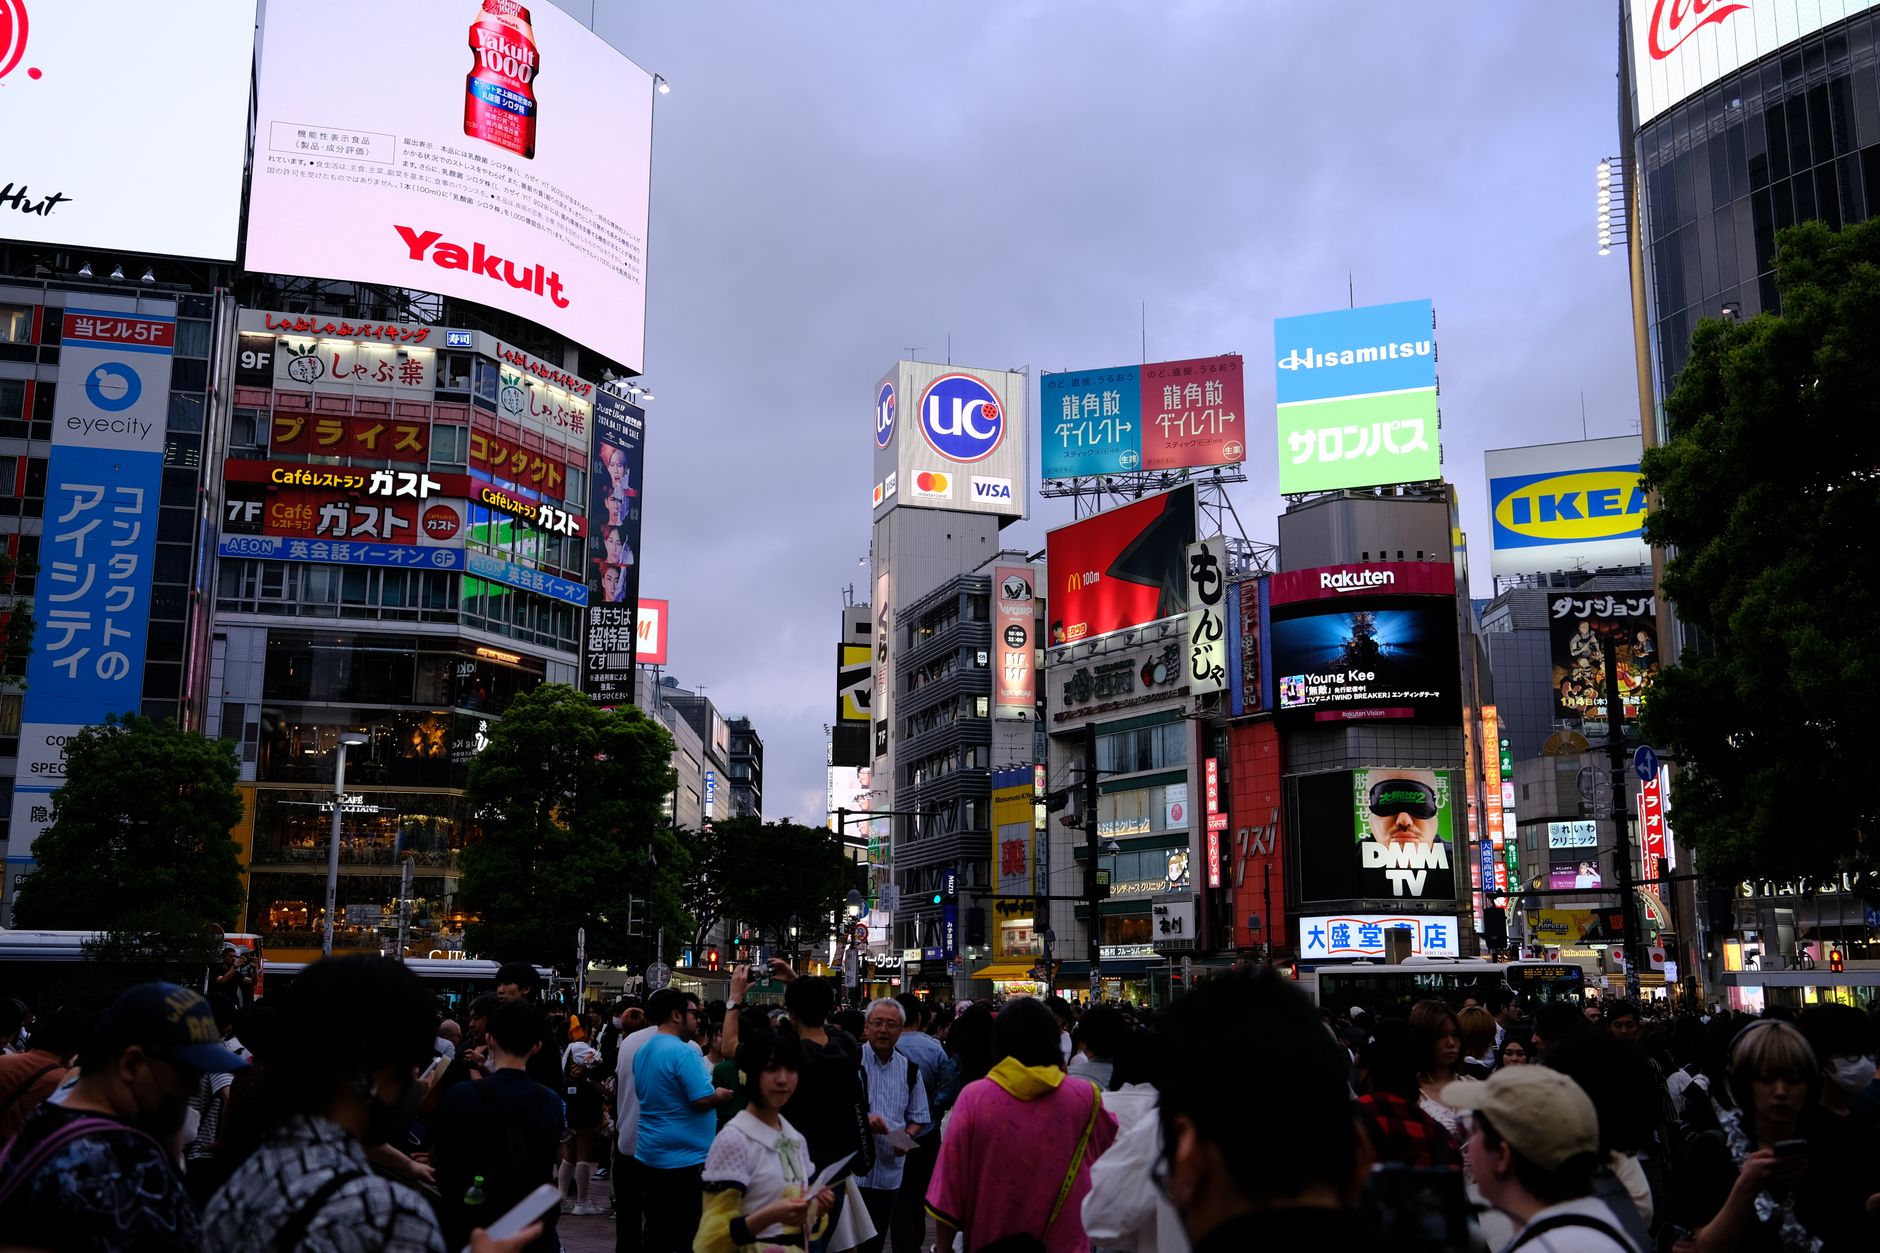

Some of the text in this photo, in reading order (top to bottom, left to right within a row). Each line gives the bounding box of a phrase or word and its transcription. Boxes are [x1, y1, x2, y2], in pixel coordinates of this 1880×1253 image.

[477, 28, 535, 66] Yakult
[476, 47, 532, 84] 1000
[297, 130, 370, 145] 機能性表示食品
[393, 224, 569, 308] Yakult
[74, 317, 164, 342] 当ビル5F
[266, 313, 431, 343] しゃぶしゃぶバイキング
[448, 332, 471, 347] 寿司
[241, 351, 270, 370] 9F
[331, 353, 424, 386] しゃぶ葉
[496, 342, 593, 397] しゃぶしゃぶバイキング
[1278, 340, 1430, 370] Hisamitsu
[1062, 389, 1121, 421] 龍角散
[1163, 380, 1223, 410] 龍角散
[529, 390, 585, 435] しゃぶ葉
[1155, 408, 1236, 438] ダイレクト
[67, 416, 152, 440] eyecity
[275, 417, 426, 454] プライス
[1054, 418, 1132, 448] ダイレクト
[1288, 417, 1429, 465] サロンパス
[470, 433, 562, 488] コンタクト
[1224, 445, 1242, 455] 生薬
[272, 467, 441, 499] Caféレストラン ガスト
[973, 482, 1011, 498] VISA
[226, 500, 263, 521] 7F
[272, 502, 313, 520] Café
[316, 502, 409, 539] ガスト
[482, 488, 580, 536] Caféレストラン ガスト
[1512, 486, 1648, 525] IKEA
[272, 519, 312, 530] レストラン
[426, 520, 456, 531] ガスト
[225, 538, 275, 556] AEON
[289, 540, 454, 566] 英会話イーオン 6F
[46, 483, 105, 679] アイシティ
[96, 486, 144, 681] コンタクトの
[507, 562, 586, 600] 英会話イーオン
[1082, 571, 1099, 586] 100m
[1320, 569, 1395, 590] Rakuten
[590, 607, 631, 625] 僕たちは
[1190, 543, 1225, 687] もんじゃ
[589, 626, 630, 651] 超特急
[1305, 669, 1375, 686] Young Kee
[706, 780, 714, 803] LABI
[1644, 777, 1661, 846] カラオケ
[1552, 836, 1595, 846] クリニック
[1562, 824, 1595, 834] れいわ
[1236, 807, 1279, 887] クスリ
[1361, 841, 1449, 870] DMM
[1385, 869, 1427, 897] TV
[1307, 922, 1447, 949] 大盛堂店
